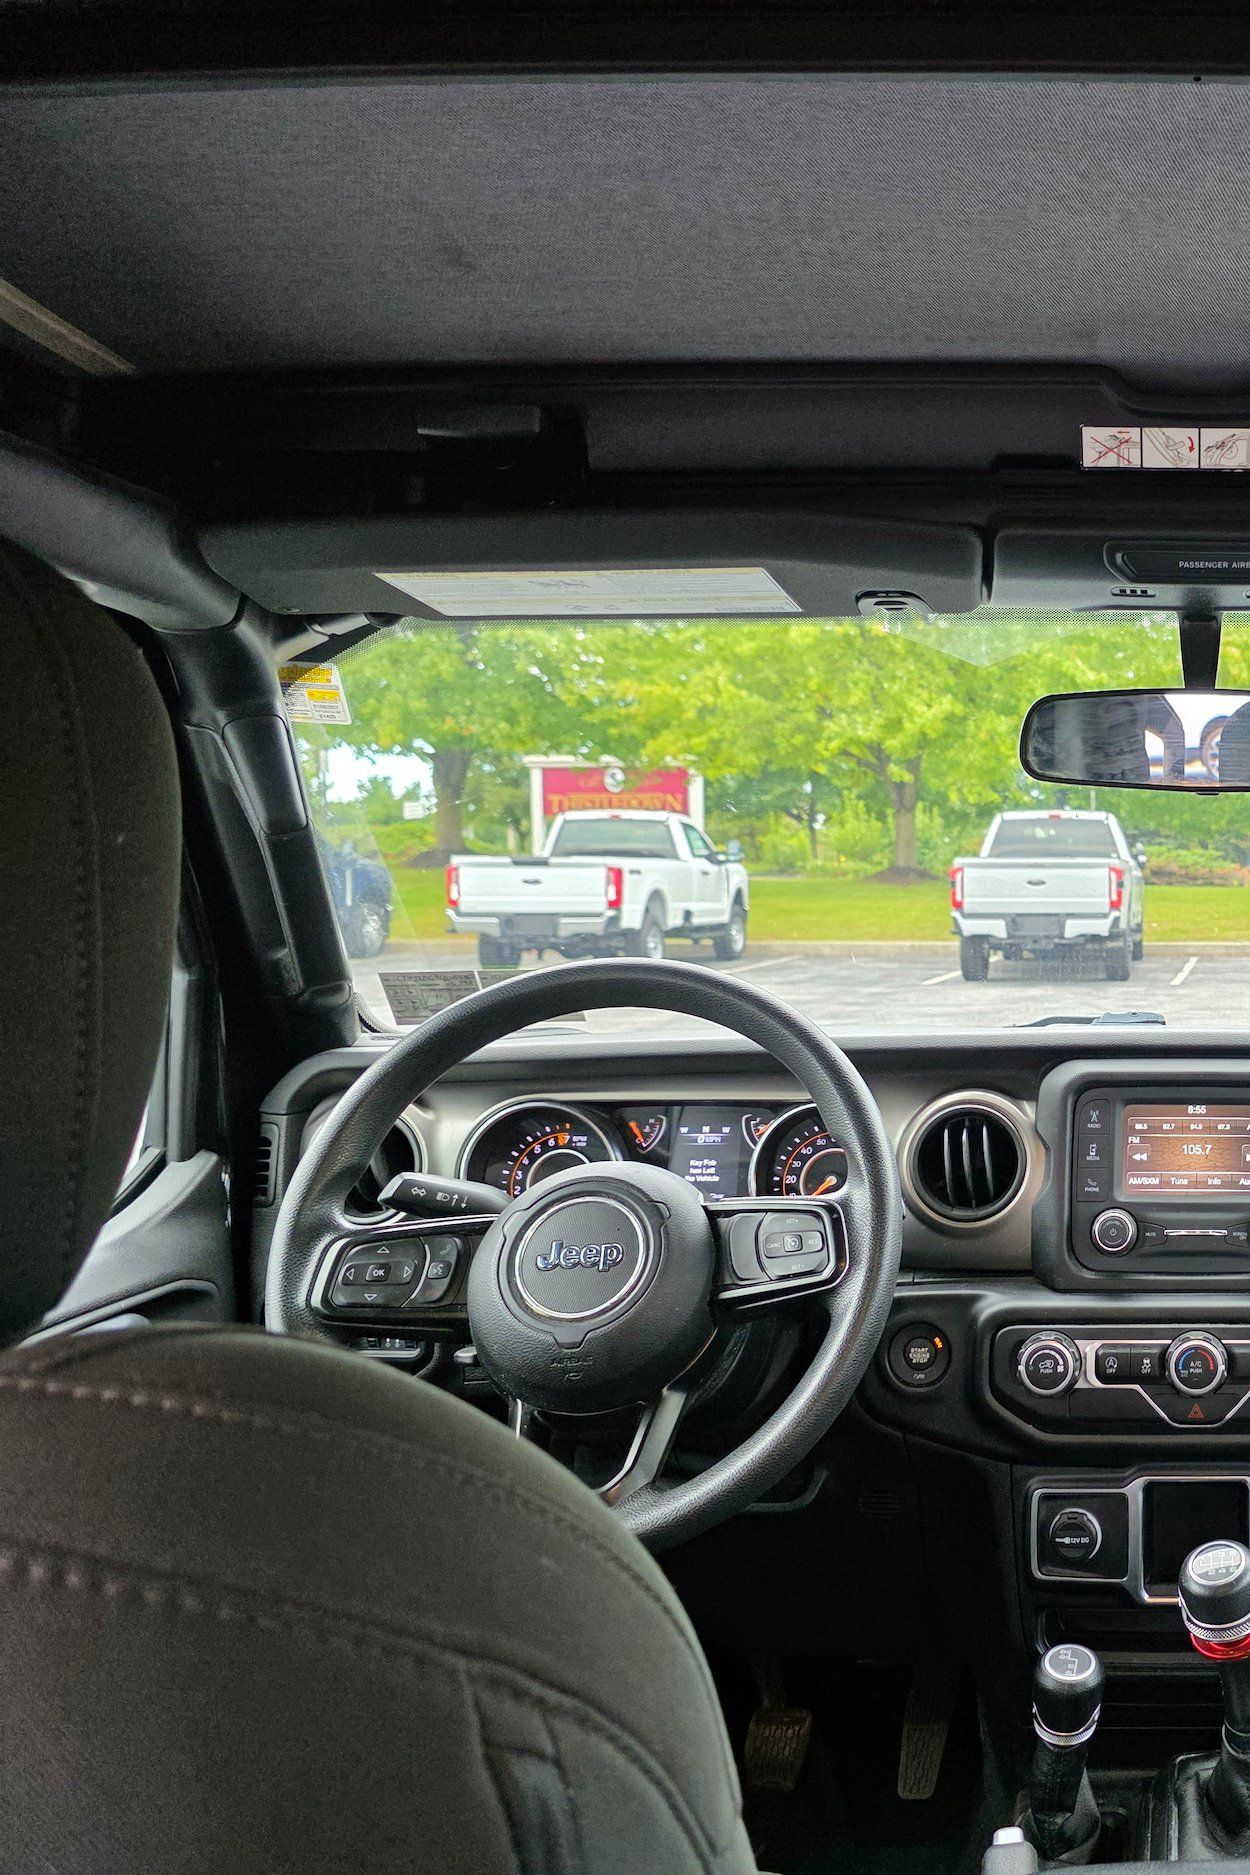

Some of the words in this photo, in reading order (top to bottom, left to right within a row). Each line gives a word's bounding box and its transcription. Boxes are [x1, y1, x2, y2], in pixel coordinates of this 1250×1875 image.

[1179, 561, 1229, 569] PASSENGER
[801, 1147, 813, 1155] 40
[1182, 1144, 1212, 1155] 105.7
[785, 1175, 797, 1183] 20
[1171, 1177, 1188, 1185] Tune
[536, 1240, 624, 1271] Jeep
